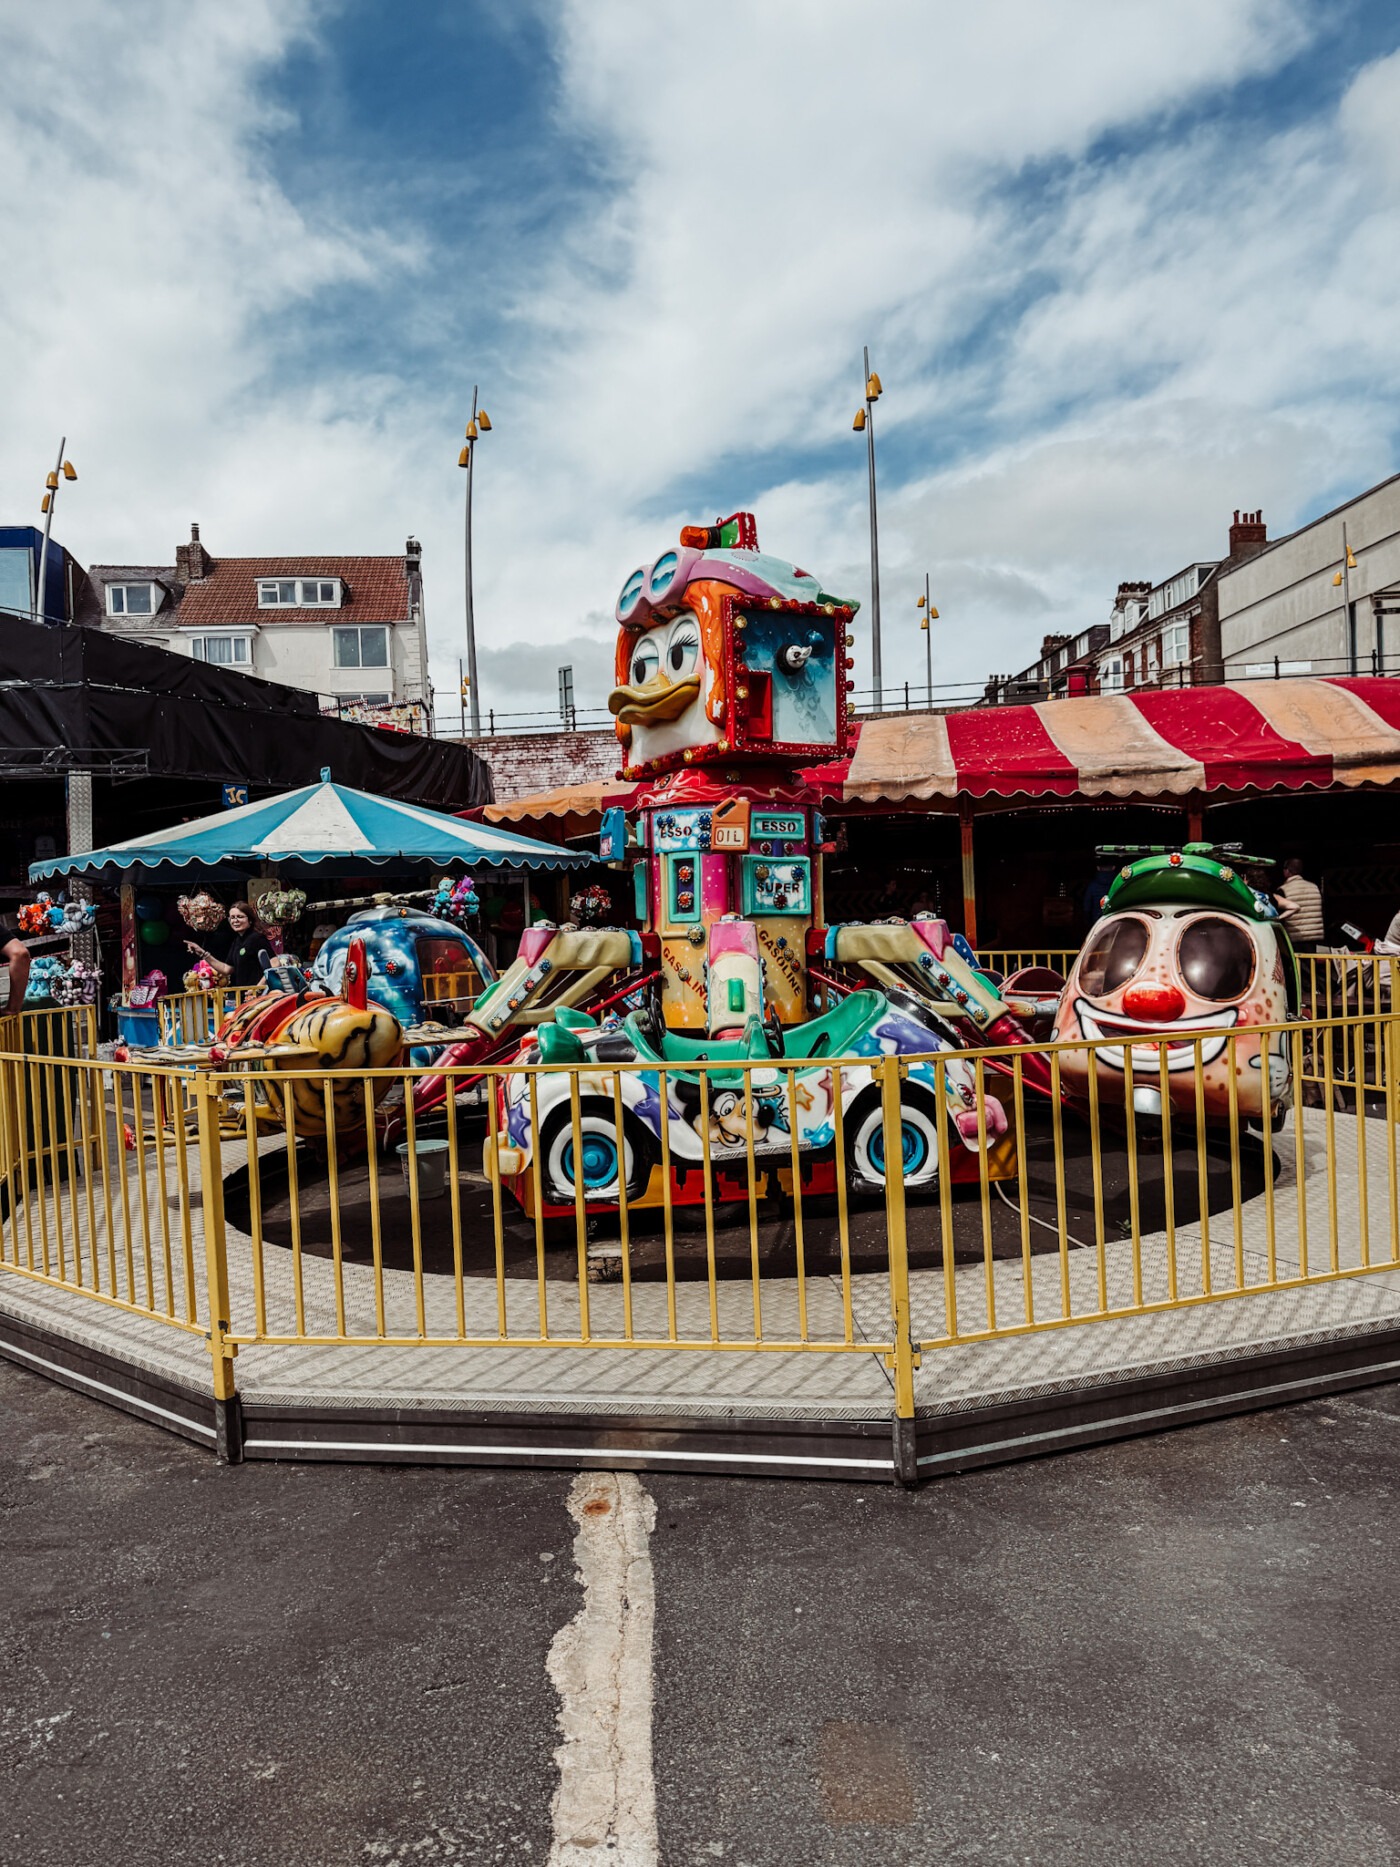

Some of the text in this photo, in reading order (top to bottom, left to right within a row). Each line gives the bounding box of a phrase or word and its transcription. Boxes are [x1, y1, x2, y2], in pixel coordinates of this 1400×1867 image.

[660, 826, 692, 839] ESSO
[762, 821, 796, 832] ESSO
[716, 830, 741, 843] OIL
[757, 882, 800, 893] SUPER
[759, 930, 802, 997] GASOLINE
[663, 947, 708, 1000] GASLIN
